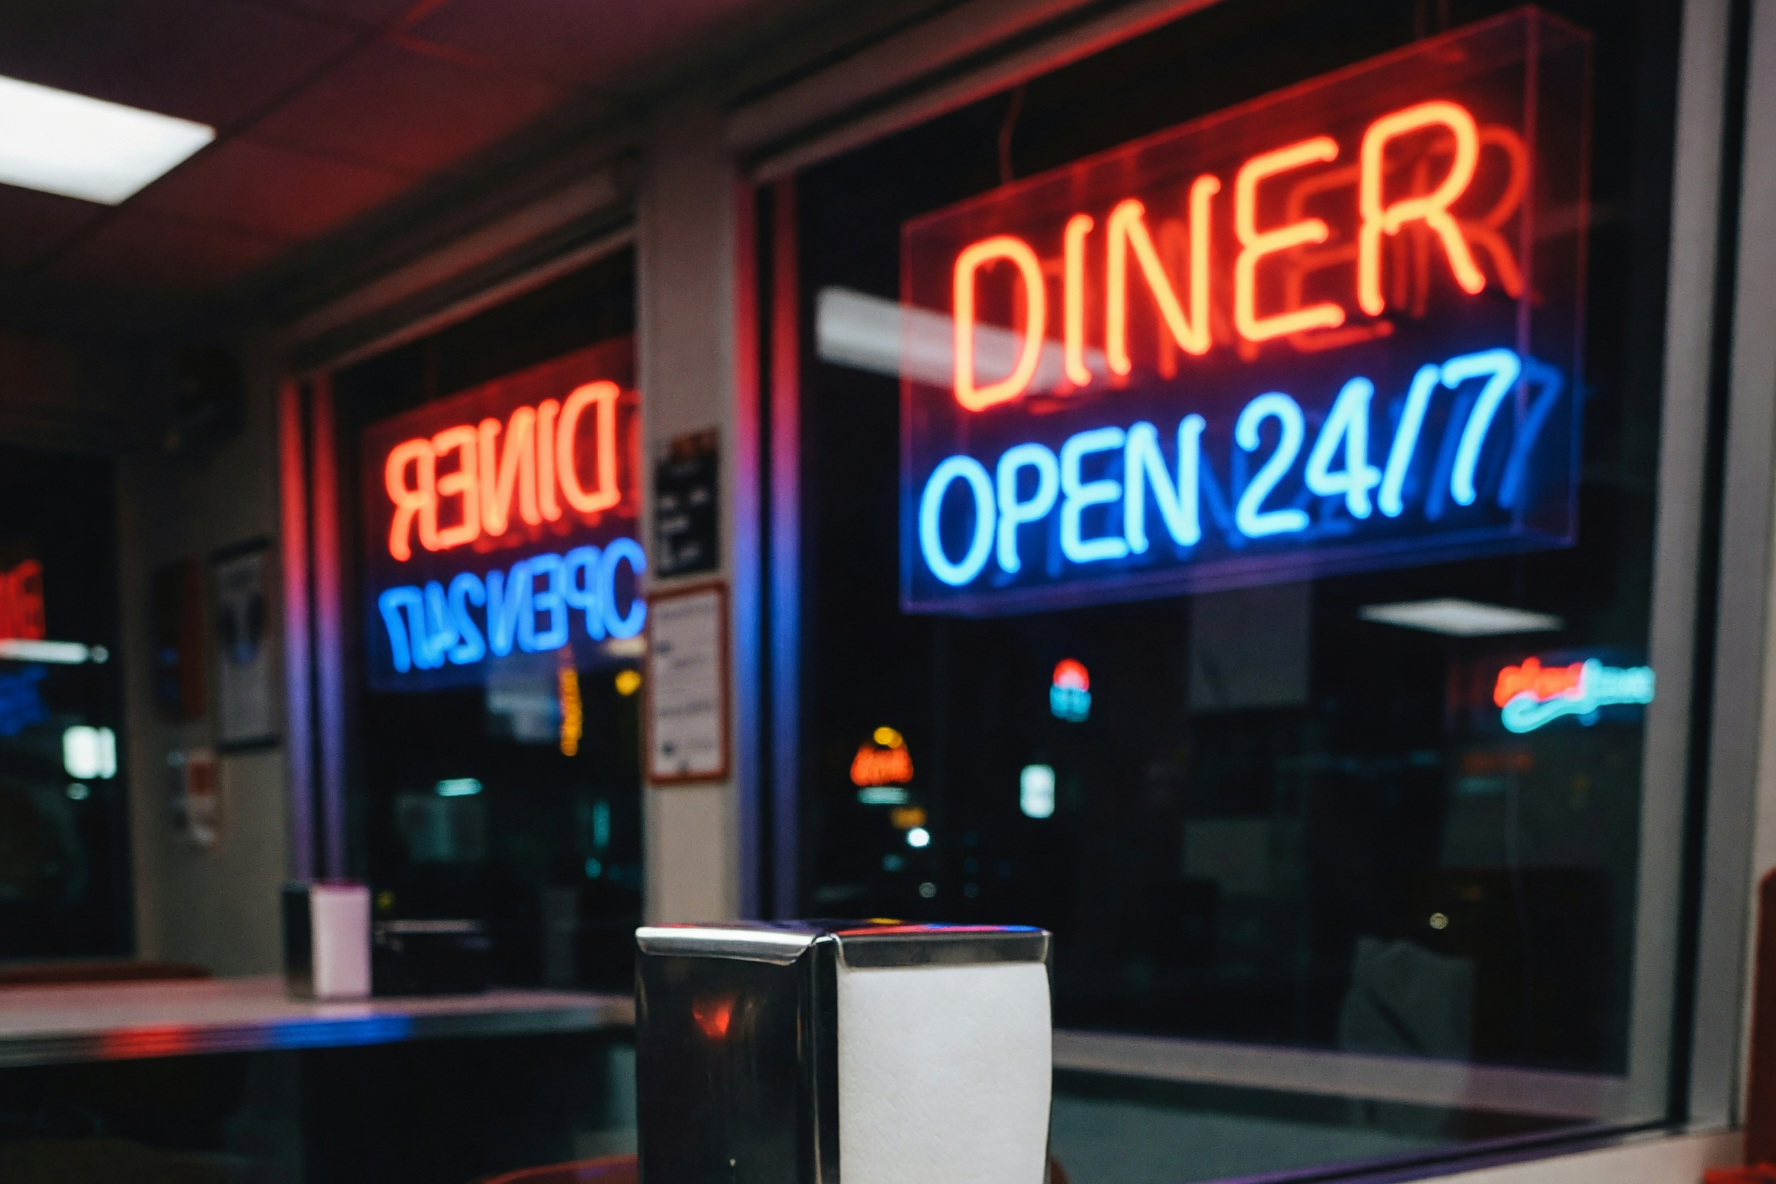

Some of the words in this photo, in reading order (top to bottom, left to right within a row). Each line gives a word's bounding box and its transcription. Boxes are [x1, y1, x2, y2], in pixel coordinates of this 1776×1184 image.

[952, 100, 1486, 413] DINER
[919, 413, 1206, 586] OPEN
[1234, 348, 1522, 538] 24/7
